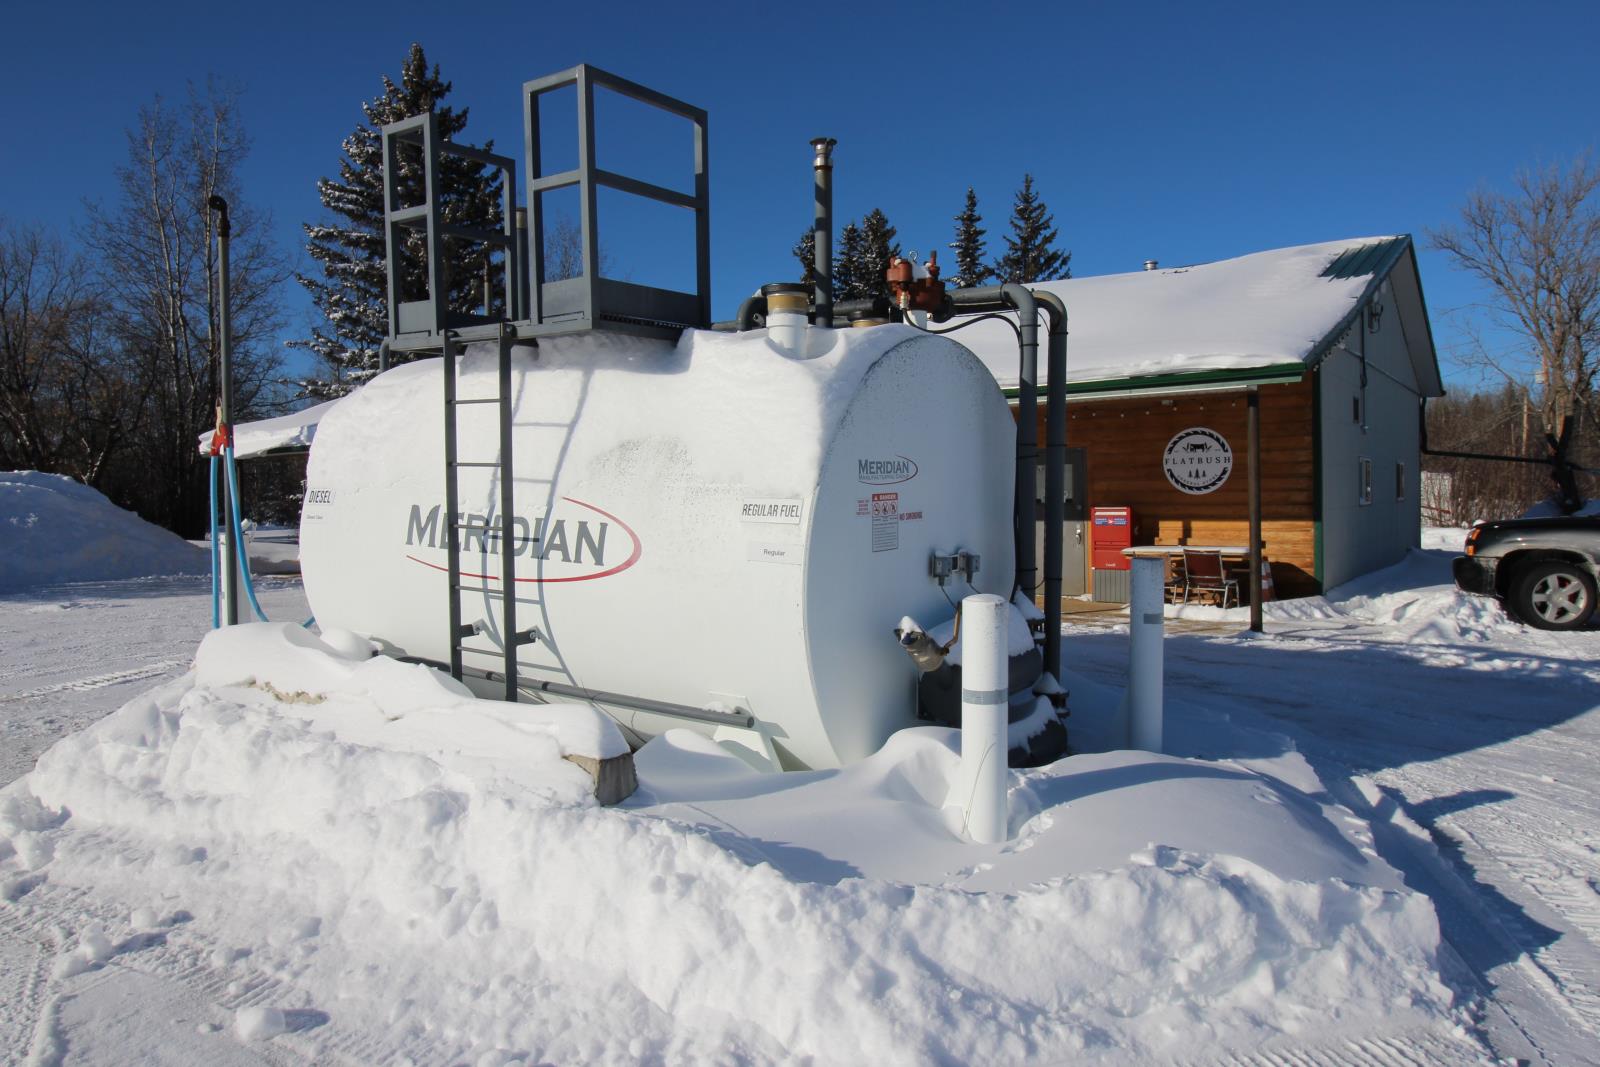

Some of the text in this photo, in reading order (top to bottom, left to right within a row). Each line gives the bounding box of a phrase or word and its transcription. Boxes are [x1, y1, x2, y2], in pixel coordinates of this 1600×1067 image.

[858, 459, 909, 474] MERIDIAN
[1164, 456, 1231, 465] FLATBUSH
[308, 490, 331, 504] DIESEL
[742, 503, 800, 518] REGULAR FUEL
[405, 504, 608, 566] MERIDIAN
[763, 548, 786, 557] Regular
